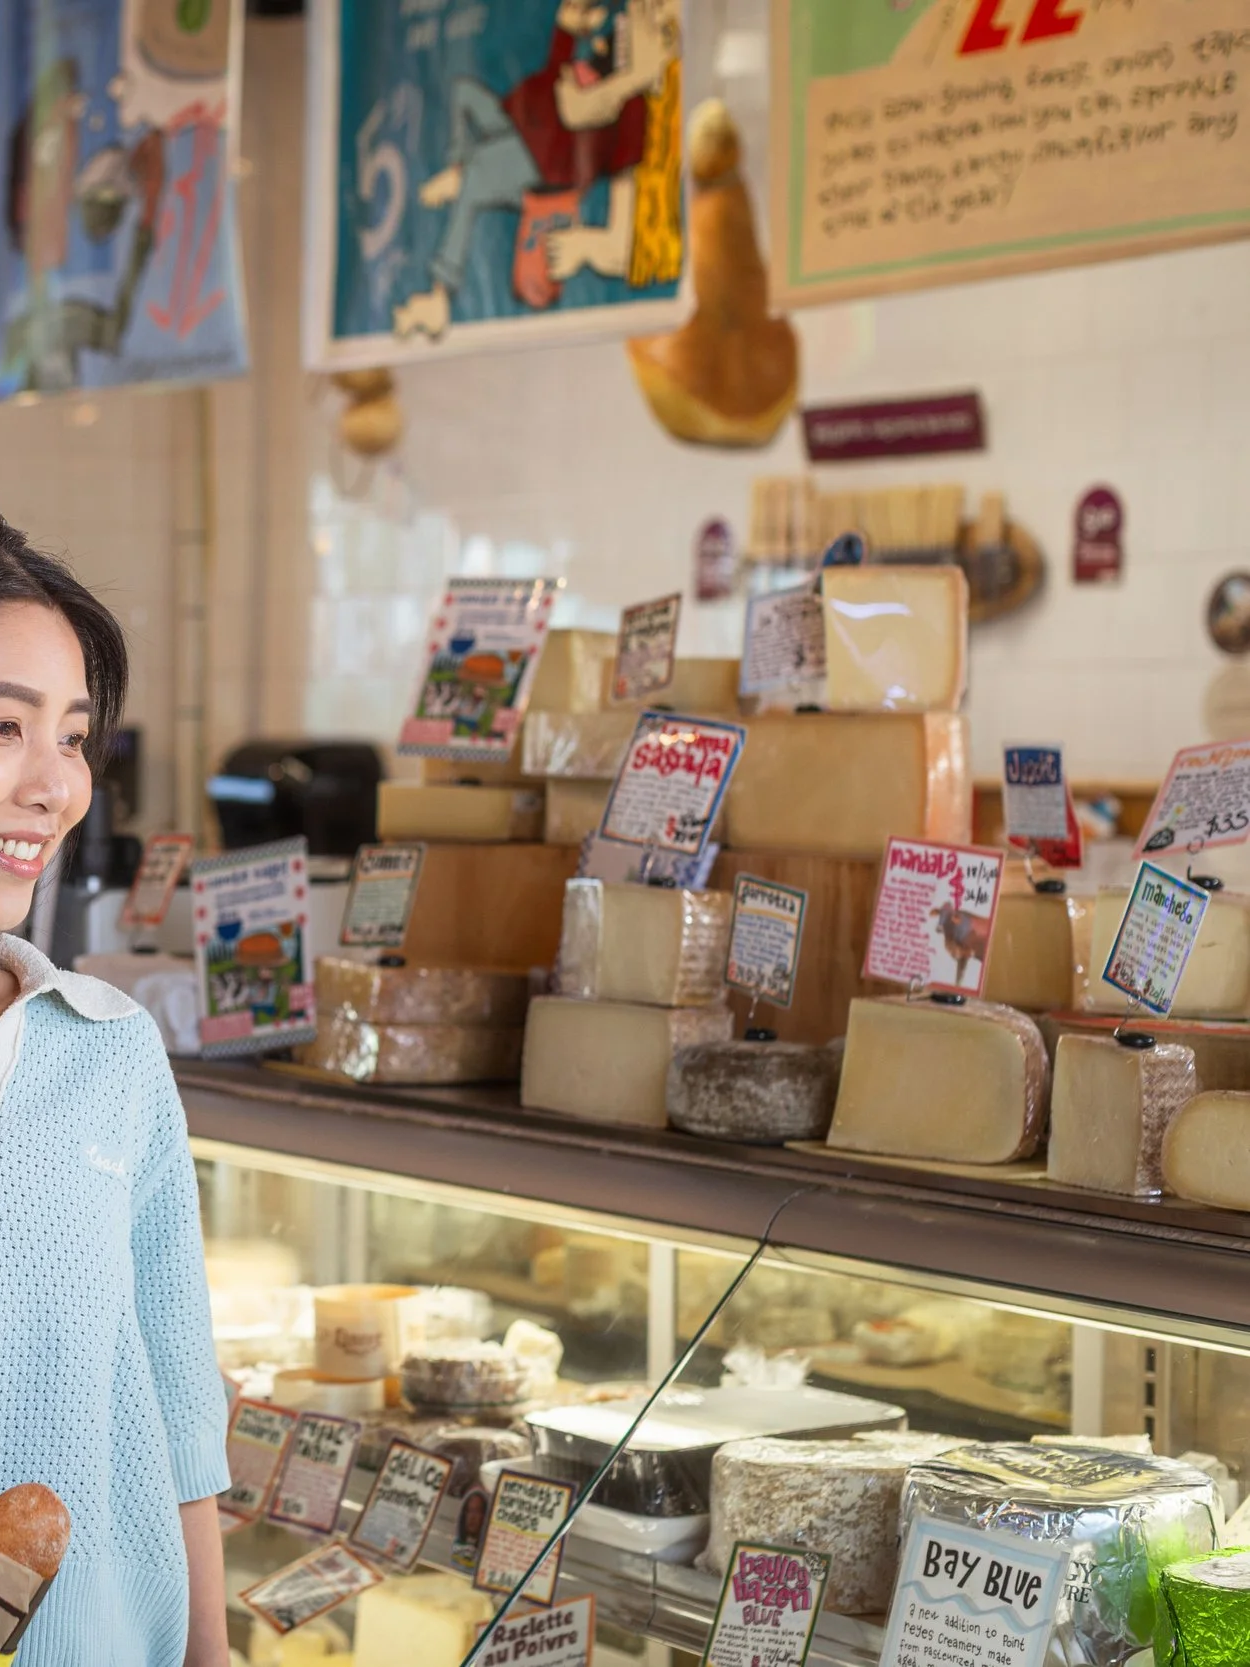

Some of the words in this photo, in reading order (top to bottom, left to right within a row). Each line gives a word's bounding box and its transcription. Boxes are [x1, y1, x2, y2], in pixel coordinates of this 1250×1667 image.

[1141, 881, 1193, 925] manchego
[922, 1539, 982, 1589] Bay
[982, 1560, 1043, 1610] BLue
[483, 1649, 510, 1667] au
[512, 1629, 578, 1662] Poivre
[491, 1610, 574, 1647] Raclette
[900, 1639, 920, 1653] from
[903, 1621, 935, 1641] reyes
[987, 1650, 1012, 1667] made
[909, 1603, 916, 1617] a
[918, 1606, 940, 1622] new
[944, 1614, 981, 1637] addition
[985, 1627, 998, 1639] to
[1002, 1636, 1026, 1652] Point
